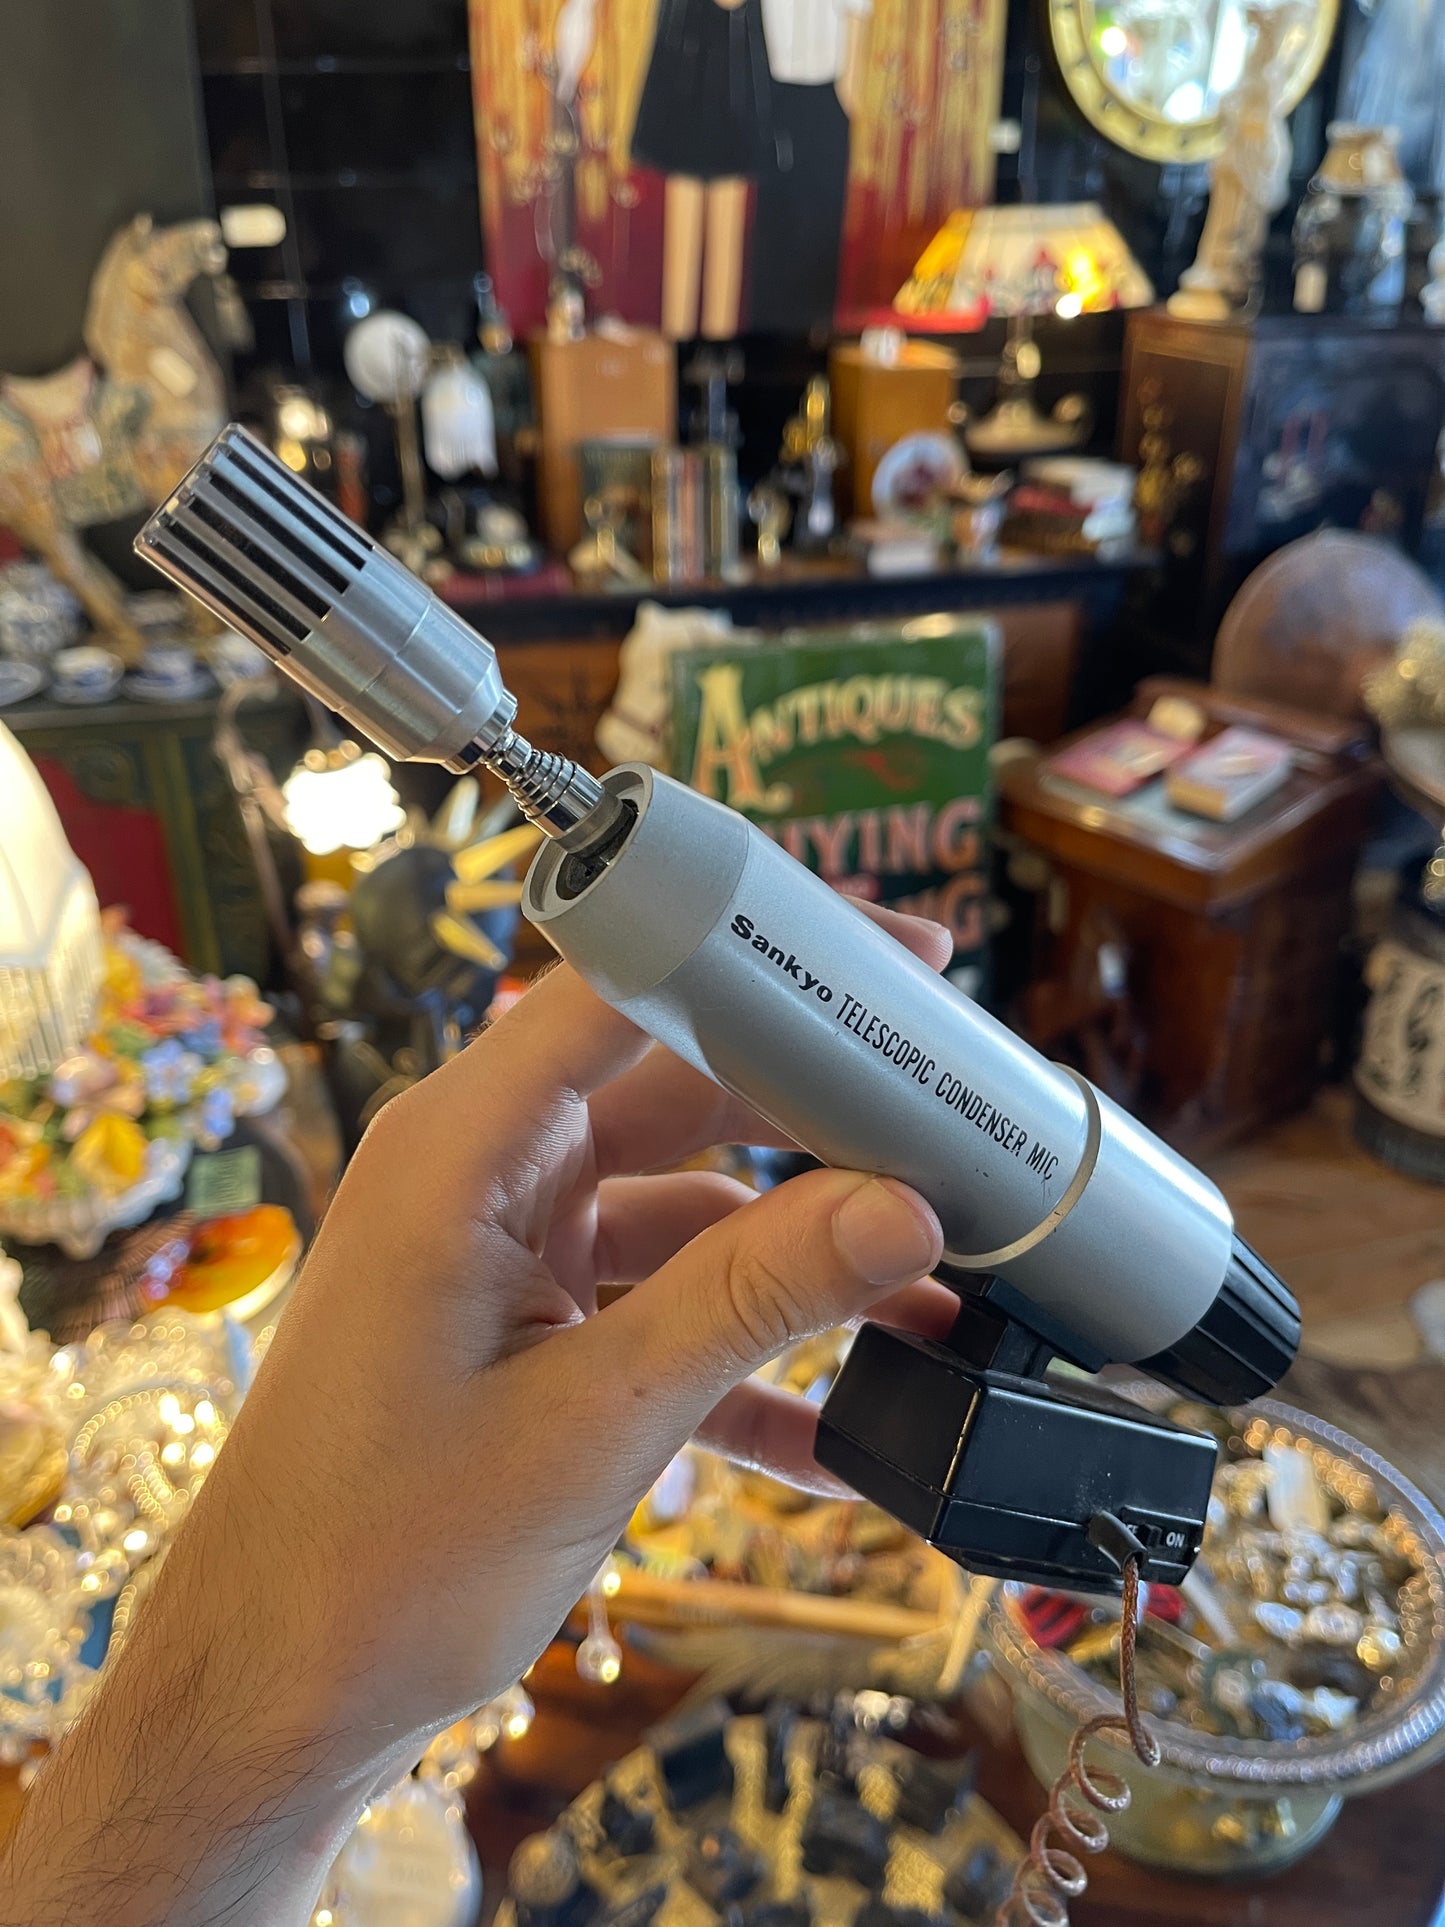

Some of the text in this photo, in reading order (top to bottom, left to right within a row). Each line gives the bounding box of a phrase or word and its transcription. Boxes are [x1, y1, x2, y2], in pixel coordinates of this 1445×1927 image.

[692, 663, 983, 812] ANTIQUES
[762, 797, 982, 874] YING
[730, 913, 1059, 1181] Sankyo TELESCOPIC CONDENSER MIC
[1166, 1532, 1185, 1548] ON
